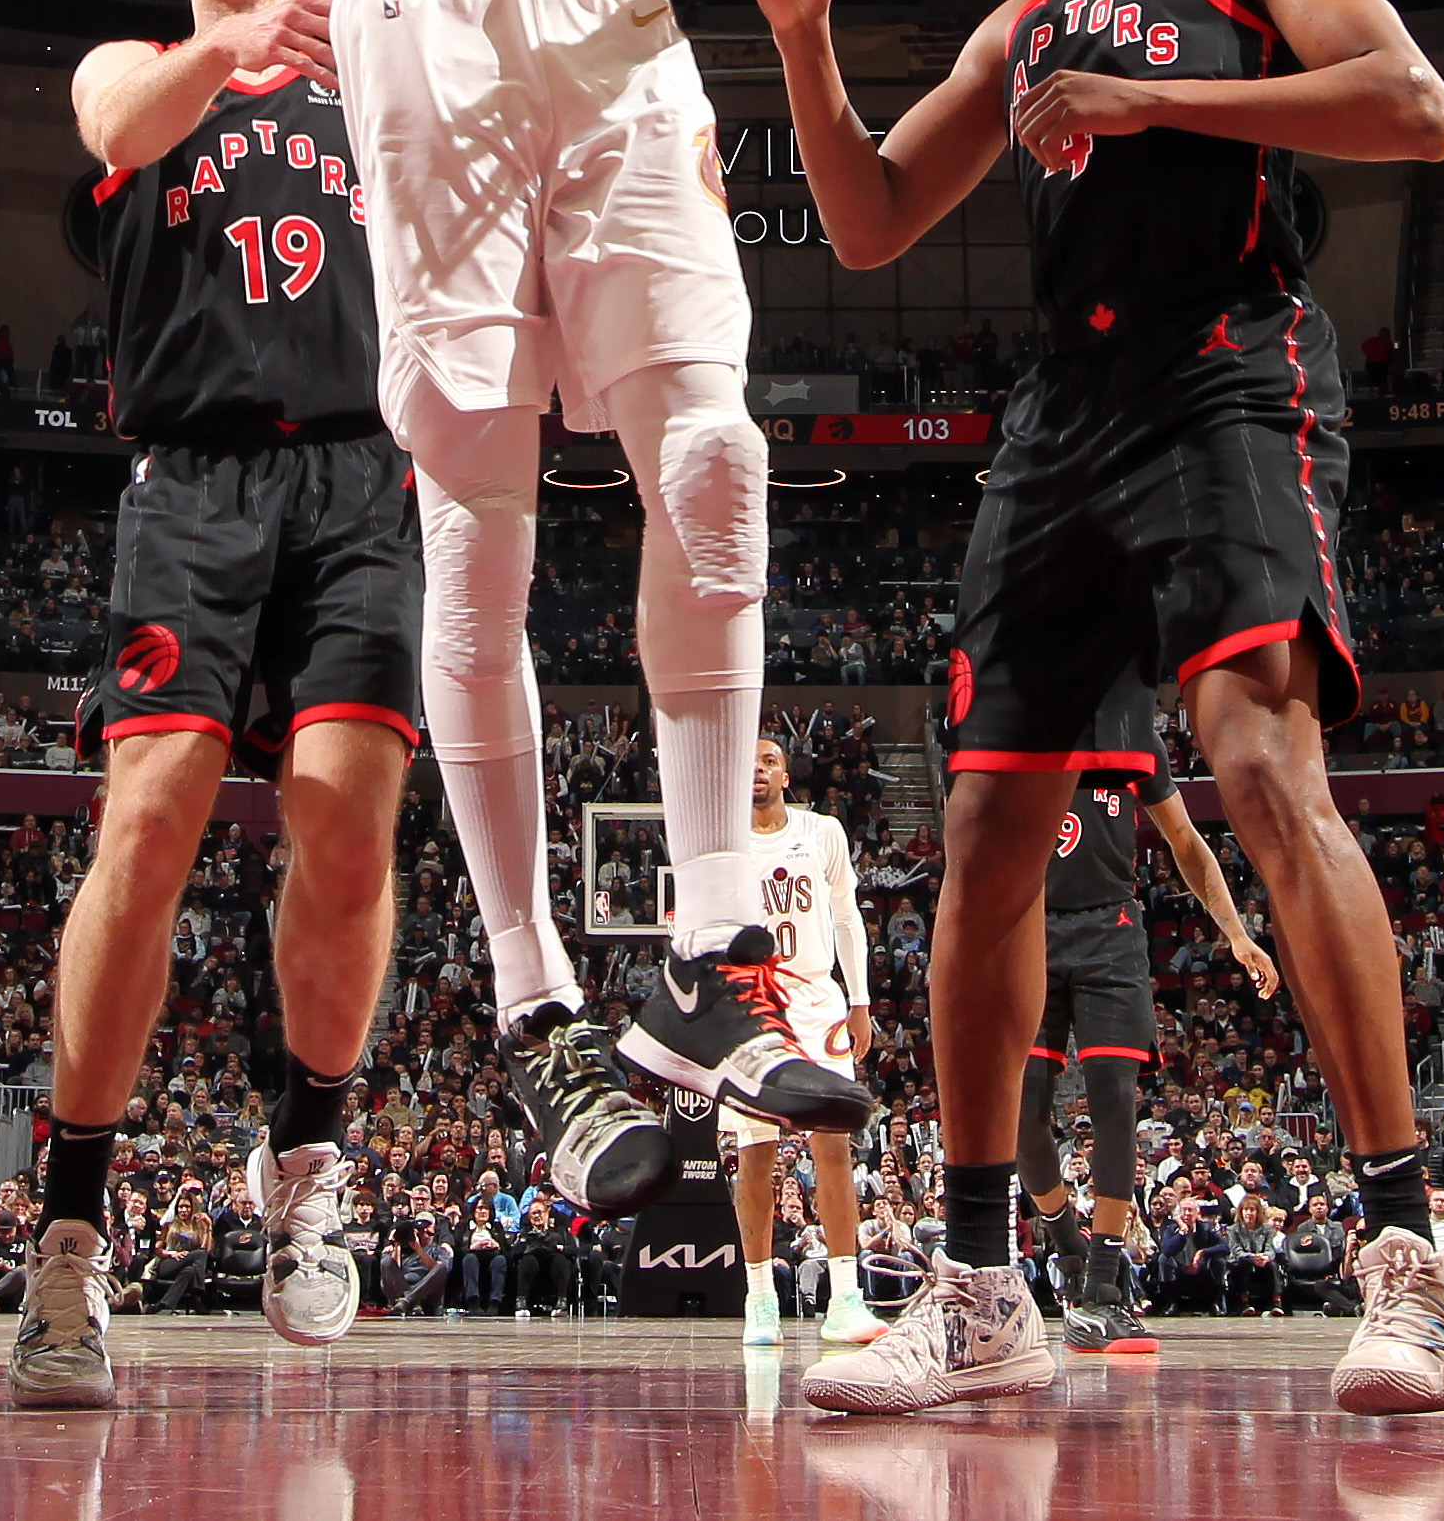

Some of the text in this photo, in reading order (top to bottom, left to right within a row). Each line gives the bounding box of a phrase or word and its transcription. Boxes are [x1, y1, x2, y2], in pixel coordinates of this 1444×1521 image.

[164, 118, 368, 229] RAPTORS
[223, 215, 326, 305] 19
[35, 408, 78, 428] TOL
[1389, 401, 1431, 422] 9:48
[760, 419, 795, 443] 4Q
[902, 418, 950, 441] 103
[761, 874, 813, 917] AVS
[677, 1089, 710, 1115] ups
[682, 1160, 718, 1171] ANTOM
